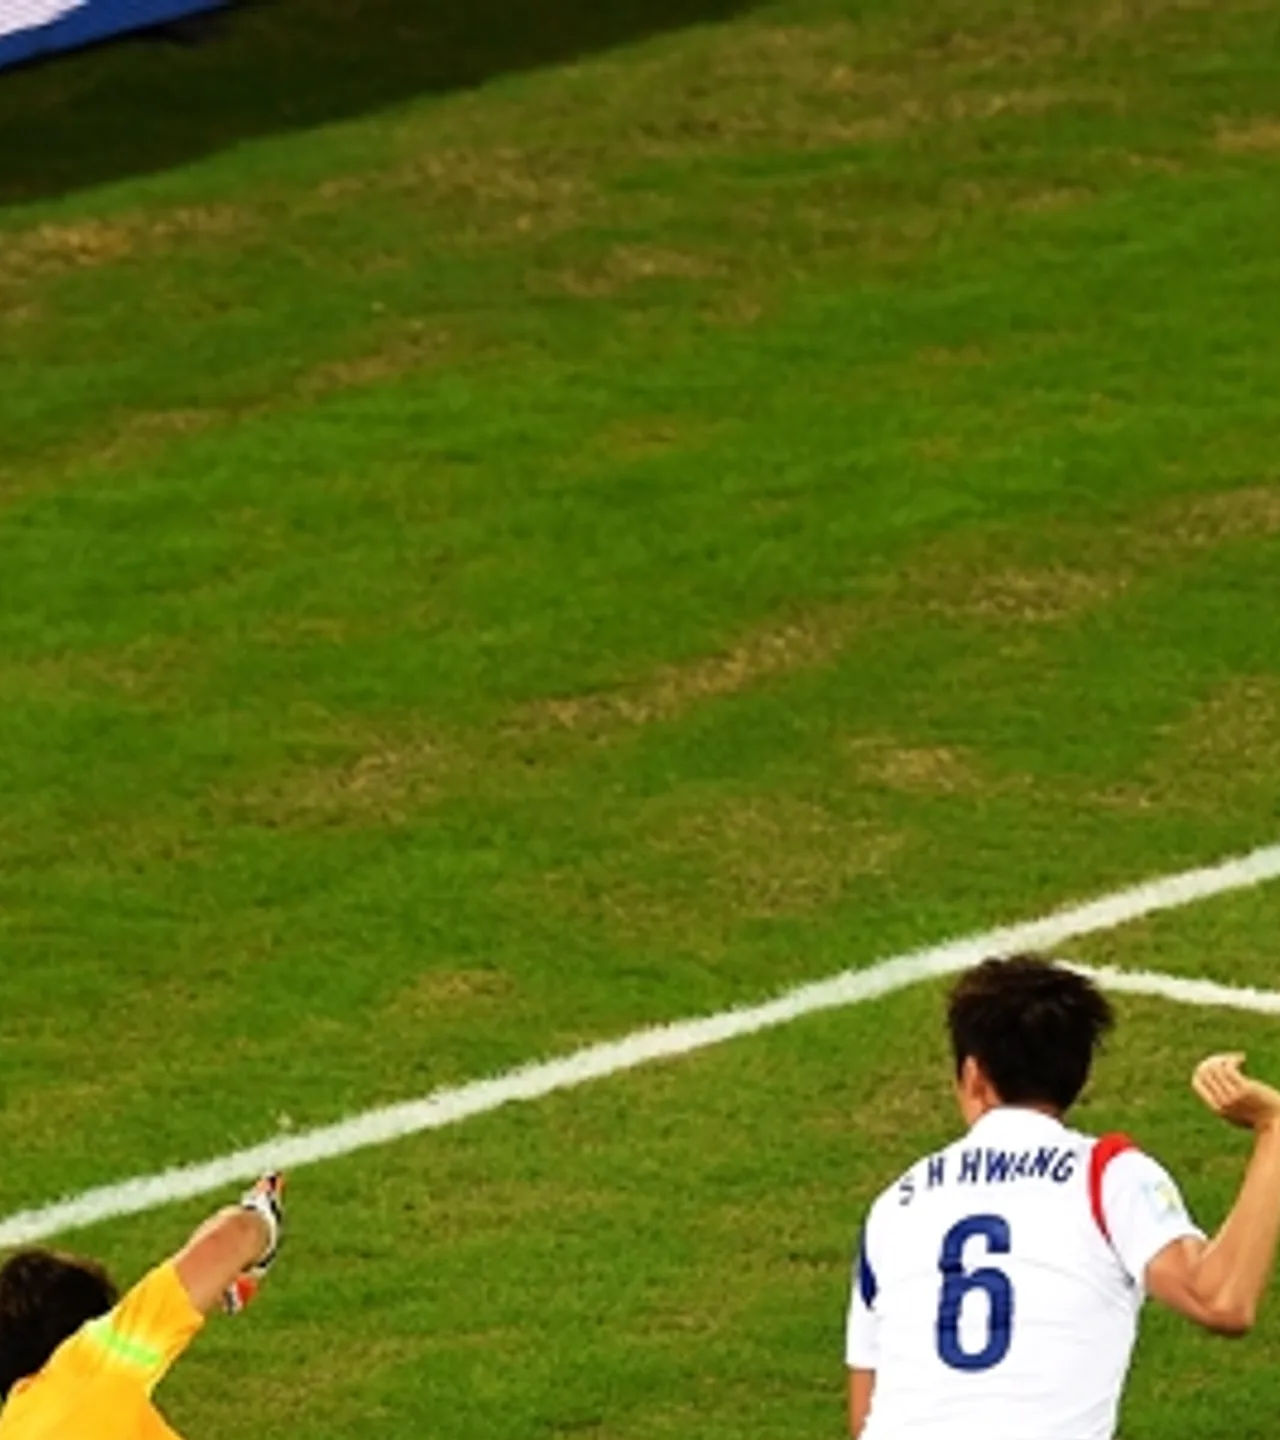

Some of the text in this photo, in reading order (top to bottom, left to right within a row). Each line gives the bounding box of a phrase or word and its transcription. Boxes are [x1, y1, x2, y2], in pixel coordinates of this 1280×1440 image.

[926, 1156, 945, 1191] H
[957, 1146, 1077, 1184] HWANG
[935, 1213, 1014, 1373] 6
